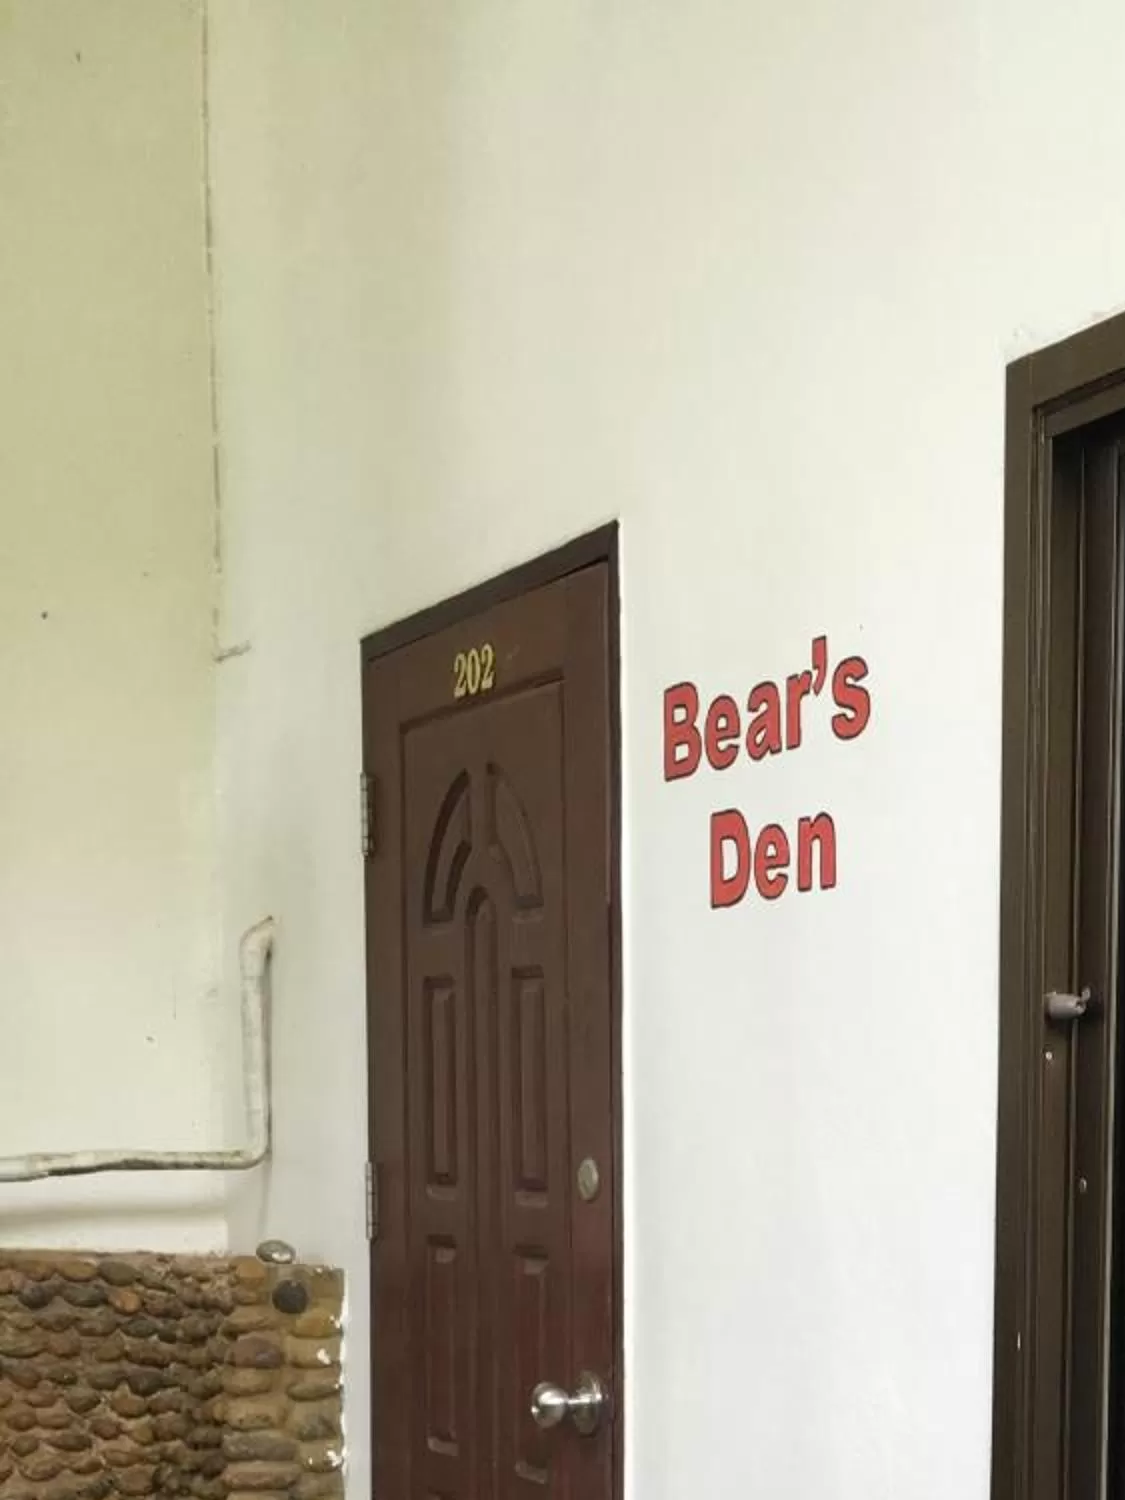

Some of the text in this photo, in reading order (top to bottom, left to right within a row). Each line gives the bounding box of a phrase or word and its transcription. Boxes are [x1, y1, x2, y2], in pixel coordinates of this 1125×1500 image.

[453, 643, 495, 698] 202
[664, 635, 871, 781] Bear's
[710, 808, 836, 909] Den
